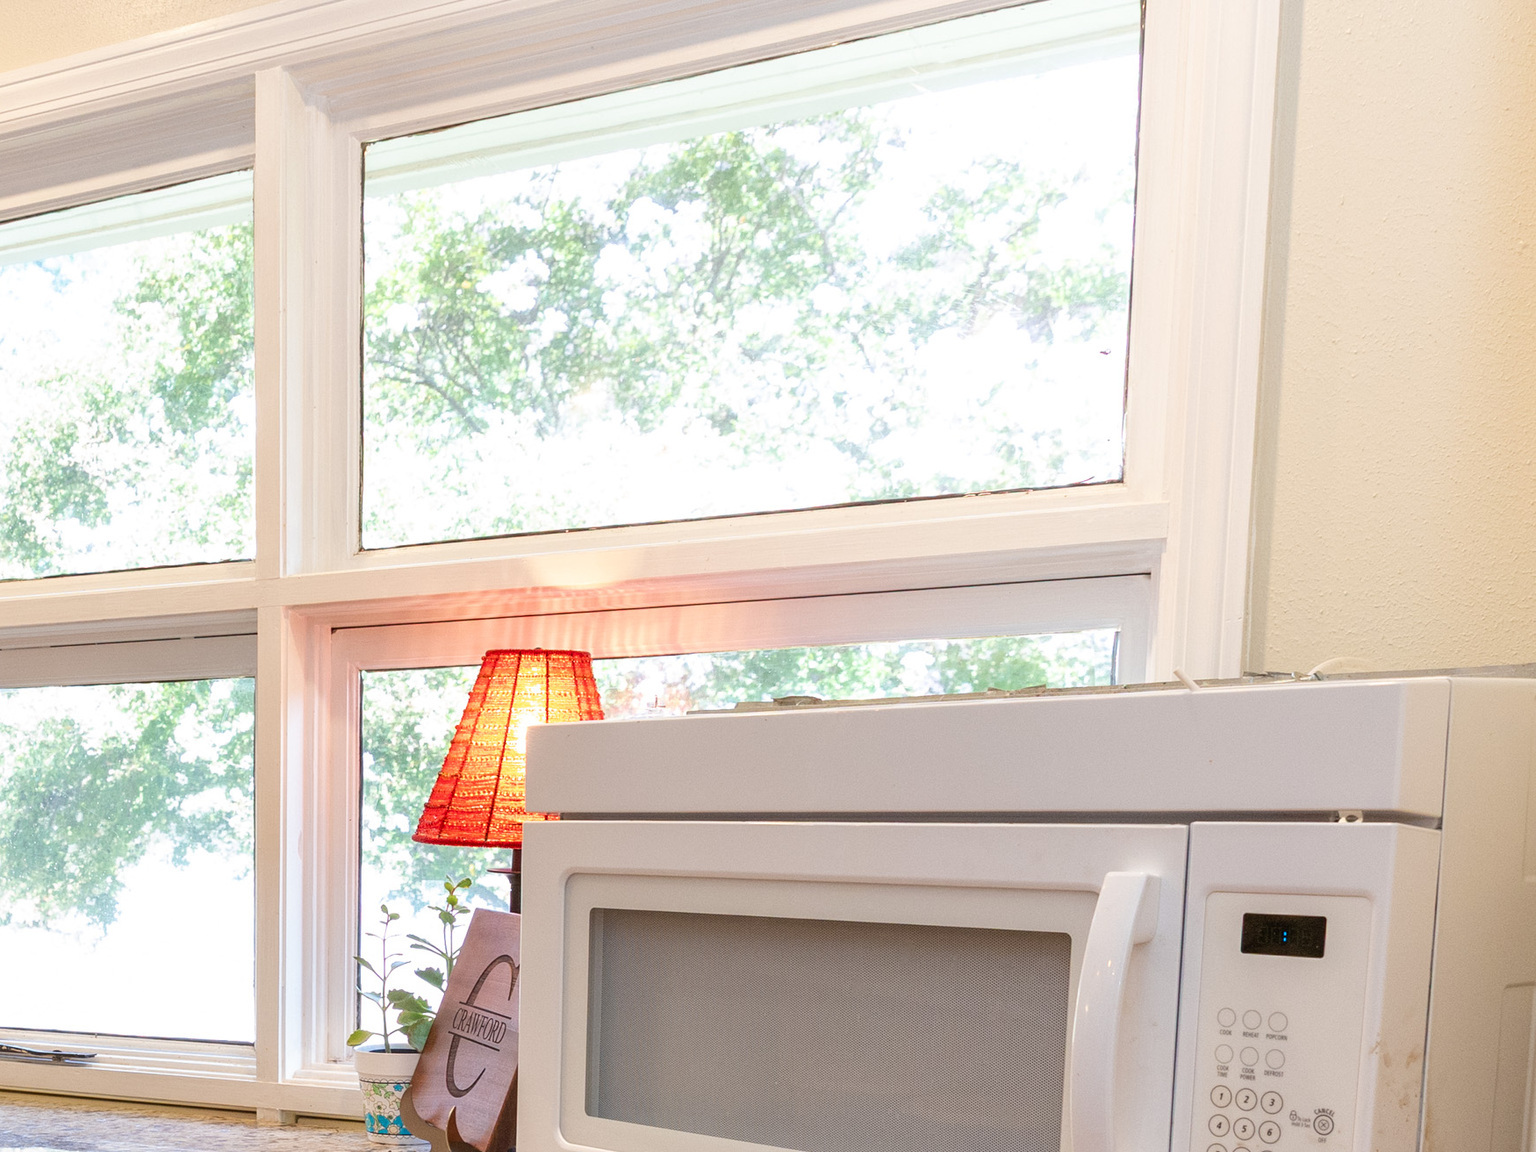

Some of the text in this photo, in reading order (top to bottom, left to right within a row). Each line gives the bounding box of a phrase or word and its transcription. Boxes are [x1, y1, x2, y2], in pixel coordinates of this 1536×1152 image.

[452, 1007, 507, 1044] CRAWFORD
[1266, 1033, 1288, 1041] POPCORN
[1219, 1092, 1224, 1100] 1
[1243, 1095, 1250, 1104] 2
[1269, 1098, 1275, 1107] 3
[1313, 1108, 1335, 1117] CANCEL
[1216, 1121, 1222, 1129] 4
[1241, 1125, 1247, 1133] 5
[1266, 1128, 1273, 1137] 6
